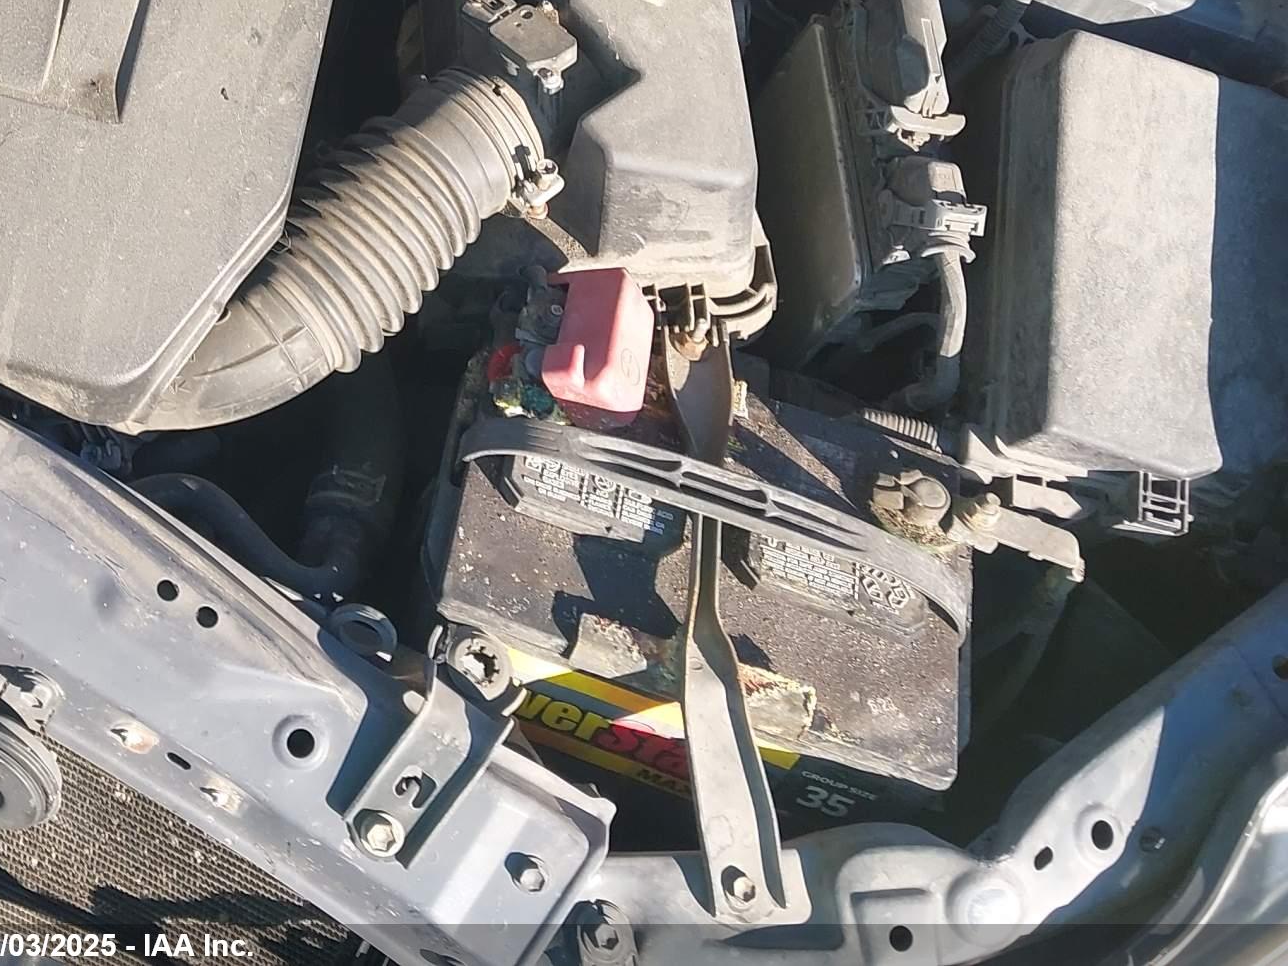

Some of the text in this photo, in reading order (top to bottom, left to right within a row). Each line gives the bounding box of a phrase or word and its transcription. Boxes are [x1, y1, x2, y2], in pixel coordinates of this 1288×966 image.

[795, 785, 857, 817] 35
[800, 770, 879, 801] GROUP SIZE
